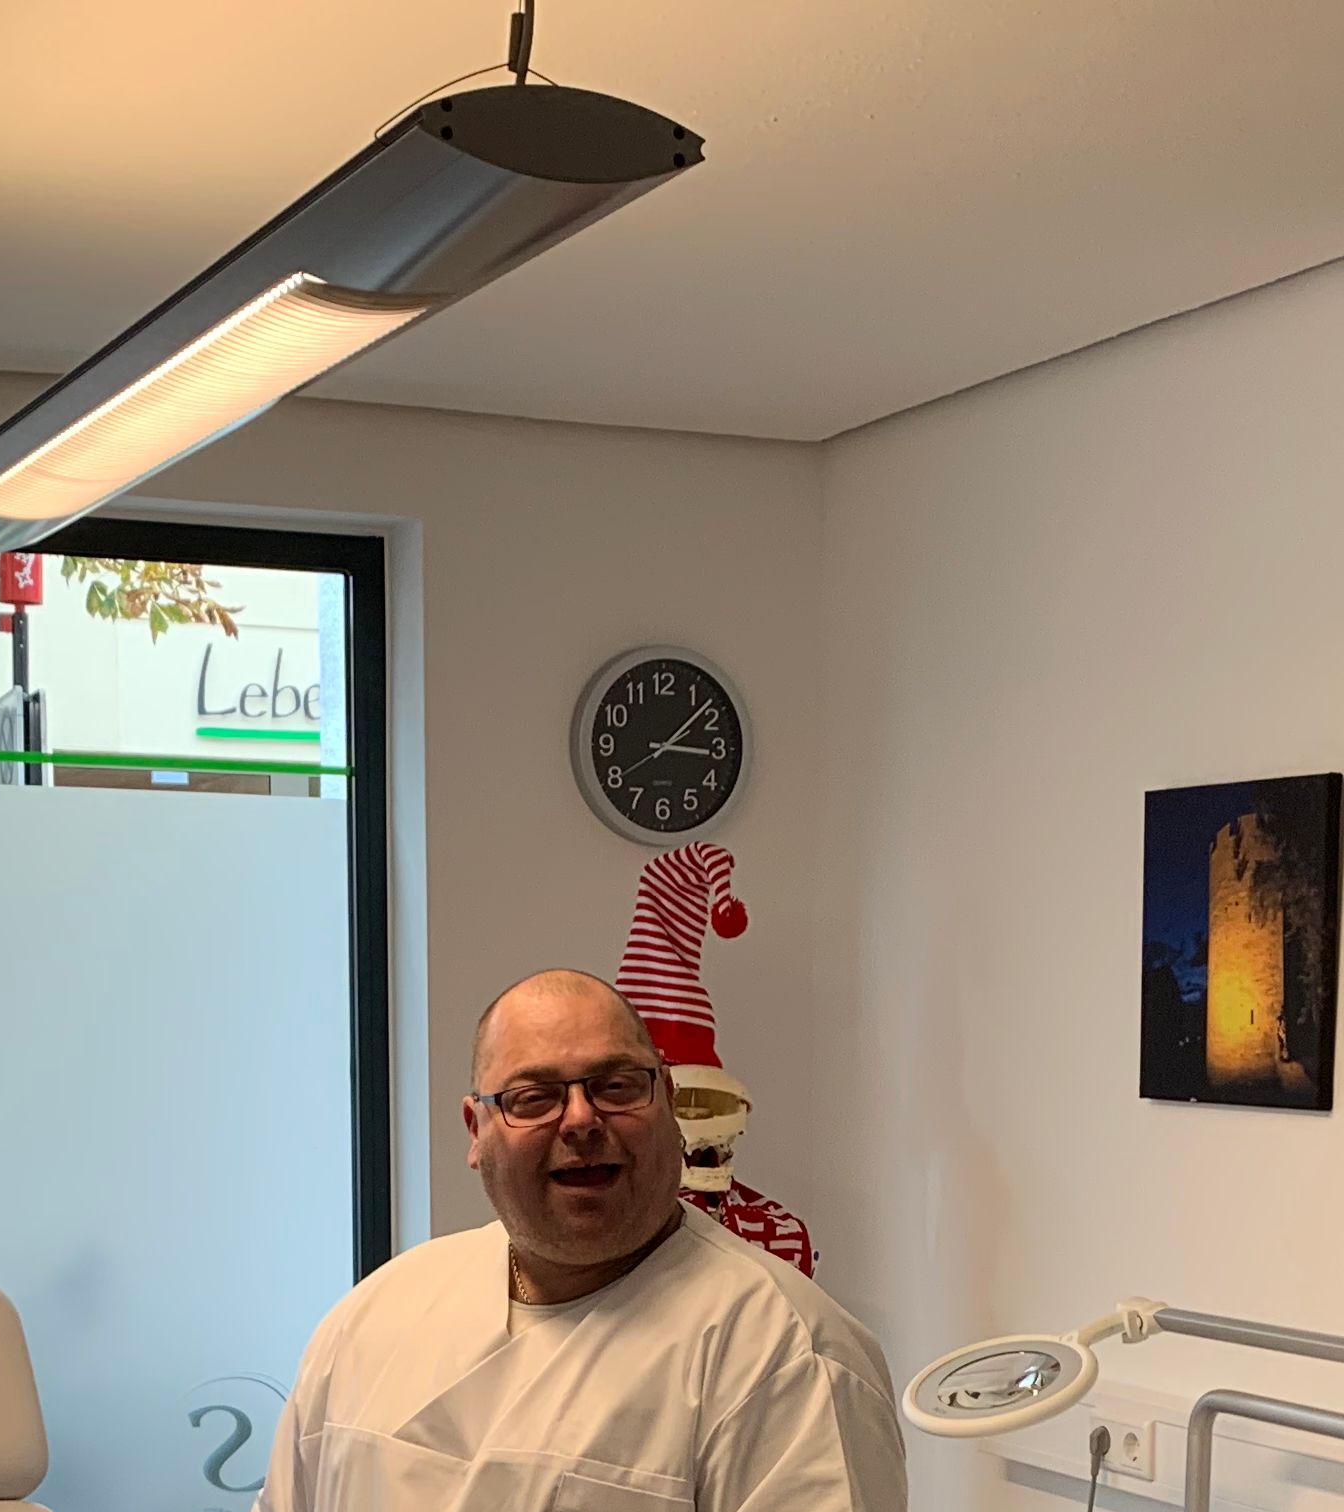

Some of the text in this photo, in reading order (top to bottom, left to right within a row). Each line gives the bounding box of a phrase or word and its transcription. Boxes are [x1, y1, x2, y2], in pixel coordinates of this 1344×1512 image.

[626, 681, 644, 704] 11
[652, 672, 675, 695] 12
[689, 684, 697, 706] 1
[605, 703, 628, 727] 10
[704, 708, 719, 731] 2
[599, 733, 615, 756] 9
[711, 737, 726, 760] 3
[607, 765, 623, 788] 8
[702, 769, 717, 791] 4
[629, 787, 644, 810] 7
[655, 797, 671, 820] 6
[683, 788, 698, 811] 5
